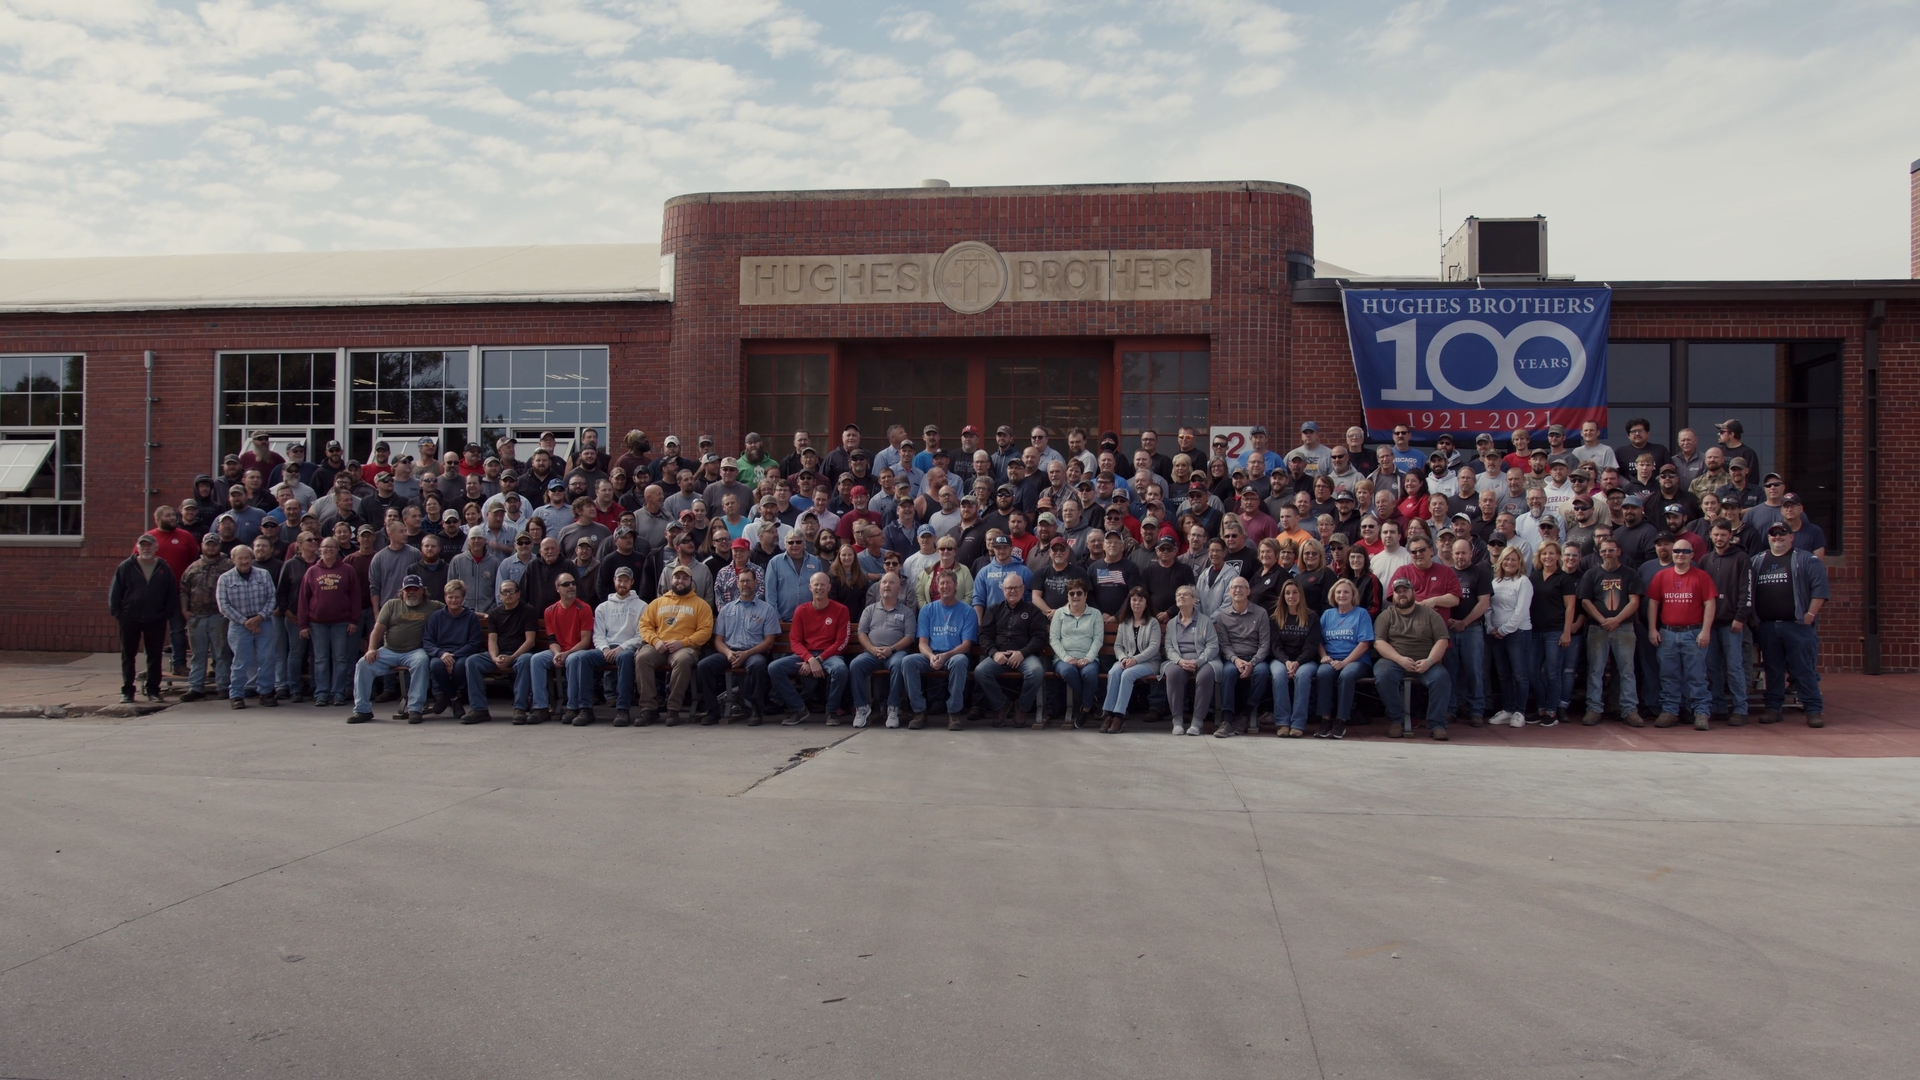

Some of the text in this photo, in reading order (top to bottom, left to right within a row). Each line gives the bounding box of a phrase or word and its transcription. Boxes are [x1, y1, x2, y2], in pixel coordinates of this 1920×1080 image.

[755, 258, 1198, 296] HUGHES BROTHERS
[1362, 297, 1596, 315] HUGHES BROTHERS
[1375, 318, 1587, 405] 100
[1517, 357, 1570, 369] YEARS
[1407, 411, 1552, 430] 1921-2021
[1227, 432, 1245, 459] 2
[1758, 573, 1788, 581] HUGHES
[1325, 629, 1354, 637] HUGHES
